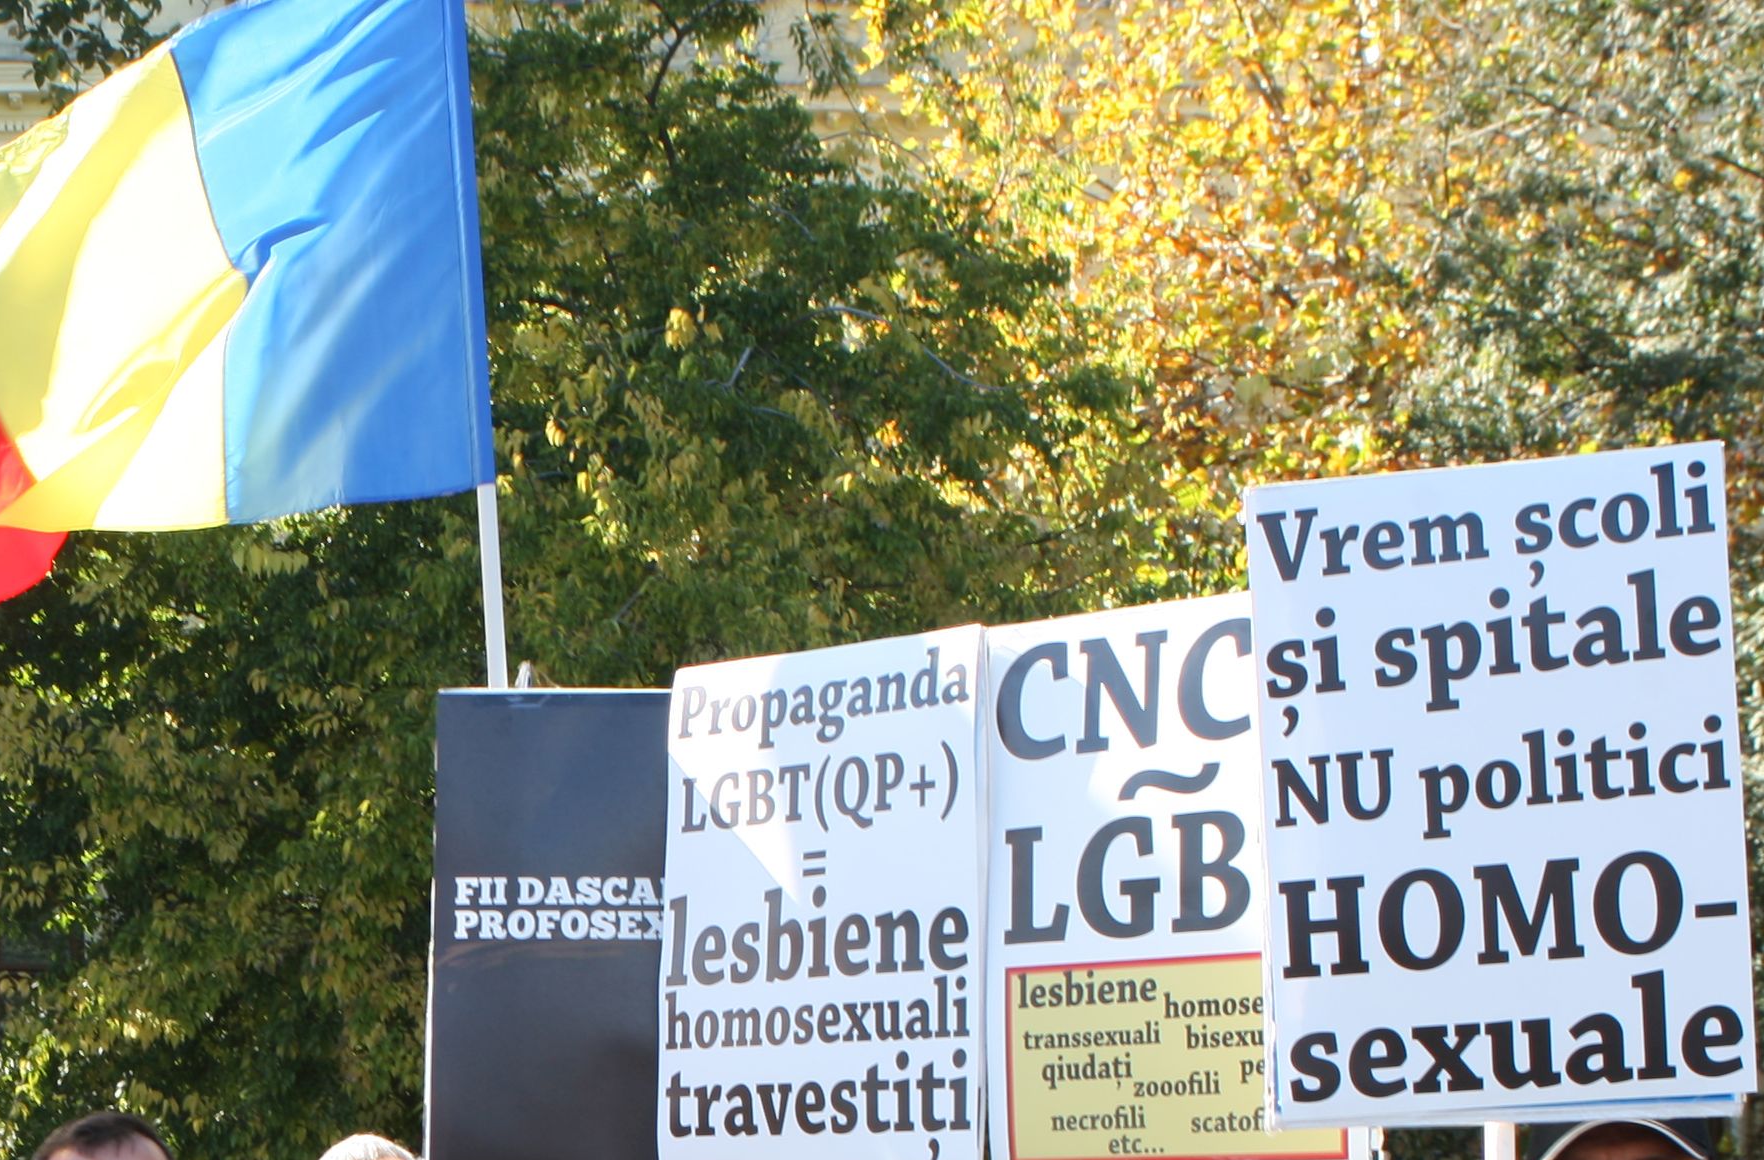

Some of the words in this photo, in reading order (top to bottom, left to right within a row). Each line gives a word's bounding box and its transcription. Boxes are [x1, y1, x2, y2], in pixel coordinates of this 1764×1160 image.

[1256, 507, 1489, 582] Vrem
[1514, 460, 1716, 588] școli
[996, 617, 1252, 760] CNC
[1266, 606, 1346, 737] și
[1374, 568, 1722, 713] spitale
[677, 647, 970, 749] Propaganda
[681, 741, 959, 834] LGBT(QP+)
[1271, 748, 1395, 828] NU
[1418, 715, 1731, 840] politici
[454, 877, 507, 905] FII
[517, 876, 665, 906] DASCA
[1004, 811, 1252, 945] LGB
[1278, 850, 1738, 980] HOMO-
[453, 909, 664, 941] PROFOSEX
[665, 885, 970, 987] lesbiene
[664, 976, 971, 1050] homosexuali
[1018, 969, 1158, 1009] lesbiene
[1164, 992, 1264, 1019] homose
[1023, 1021, 1161, 1051] transsexuali
[1186, 1024, 1264, 1050] bisexu
[1240, 1055, 1265, 1083] pe
[1289, 969, 1744, 1102] sexuale
[1051, 1106, 1146, 1132] necrofili
[1133, 1071, 1221, 1098] zooofili
[1190, 1107, 1263, 1134] scatof
